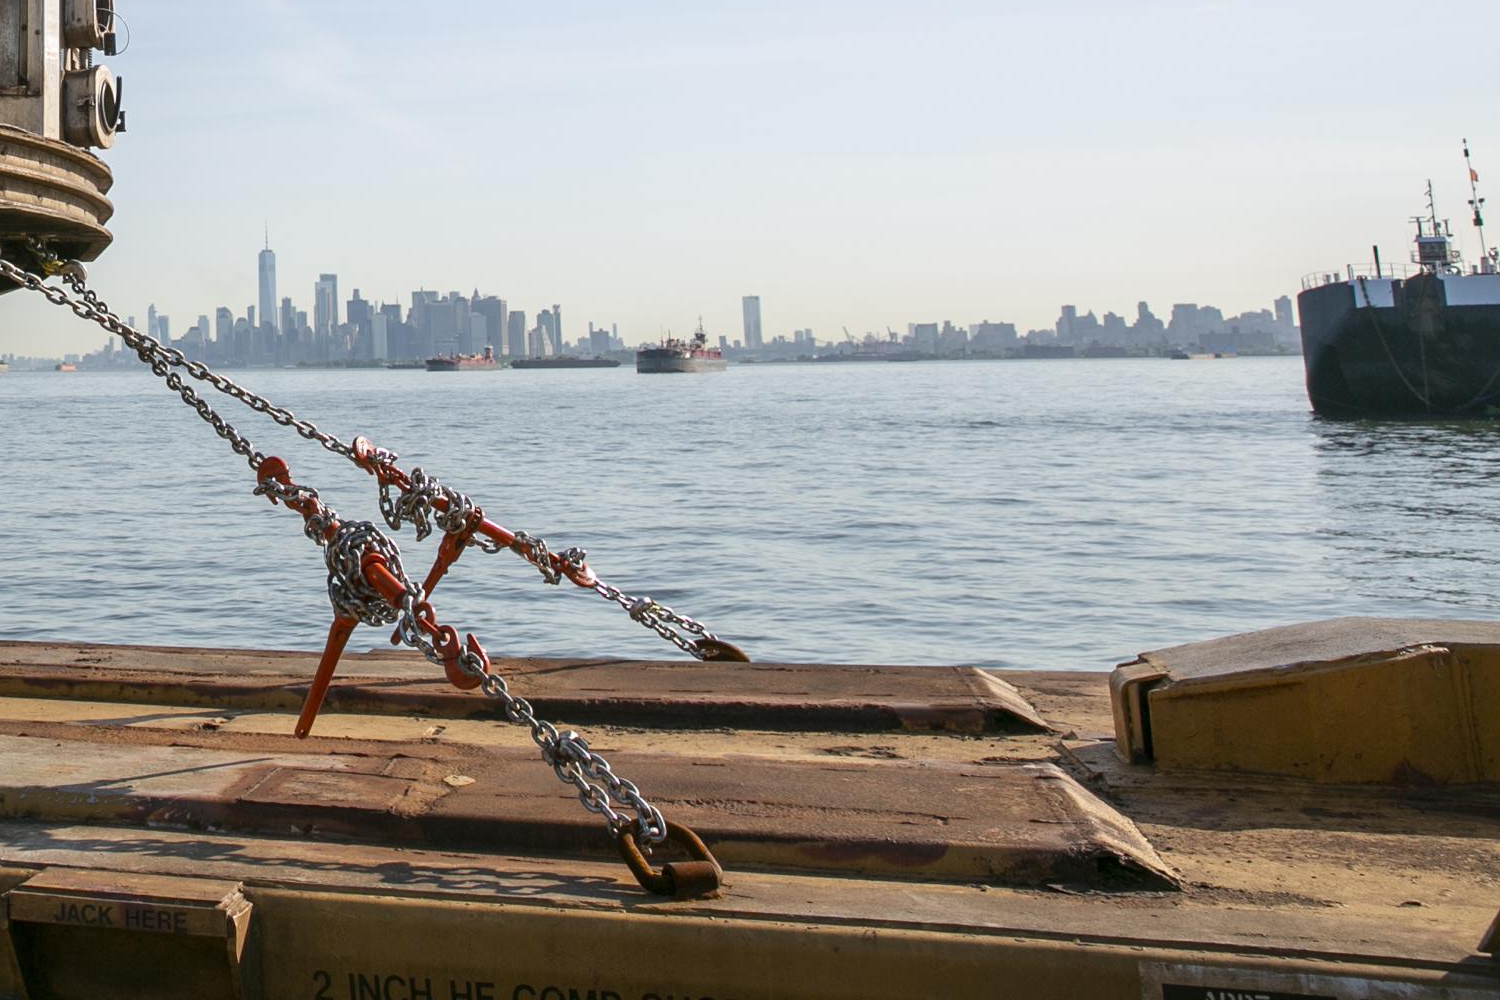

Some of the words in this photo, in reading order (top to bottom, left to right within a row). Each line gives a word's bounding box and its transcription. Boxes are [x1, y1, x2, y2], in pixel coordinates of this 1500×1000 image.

[53, 903, 113, 926] JACK
[125, 909, 188, 932] HERE
[313, 970, 334, 1000] 2
[348, 973, 432, 1000] INCH
